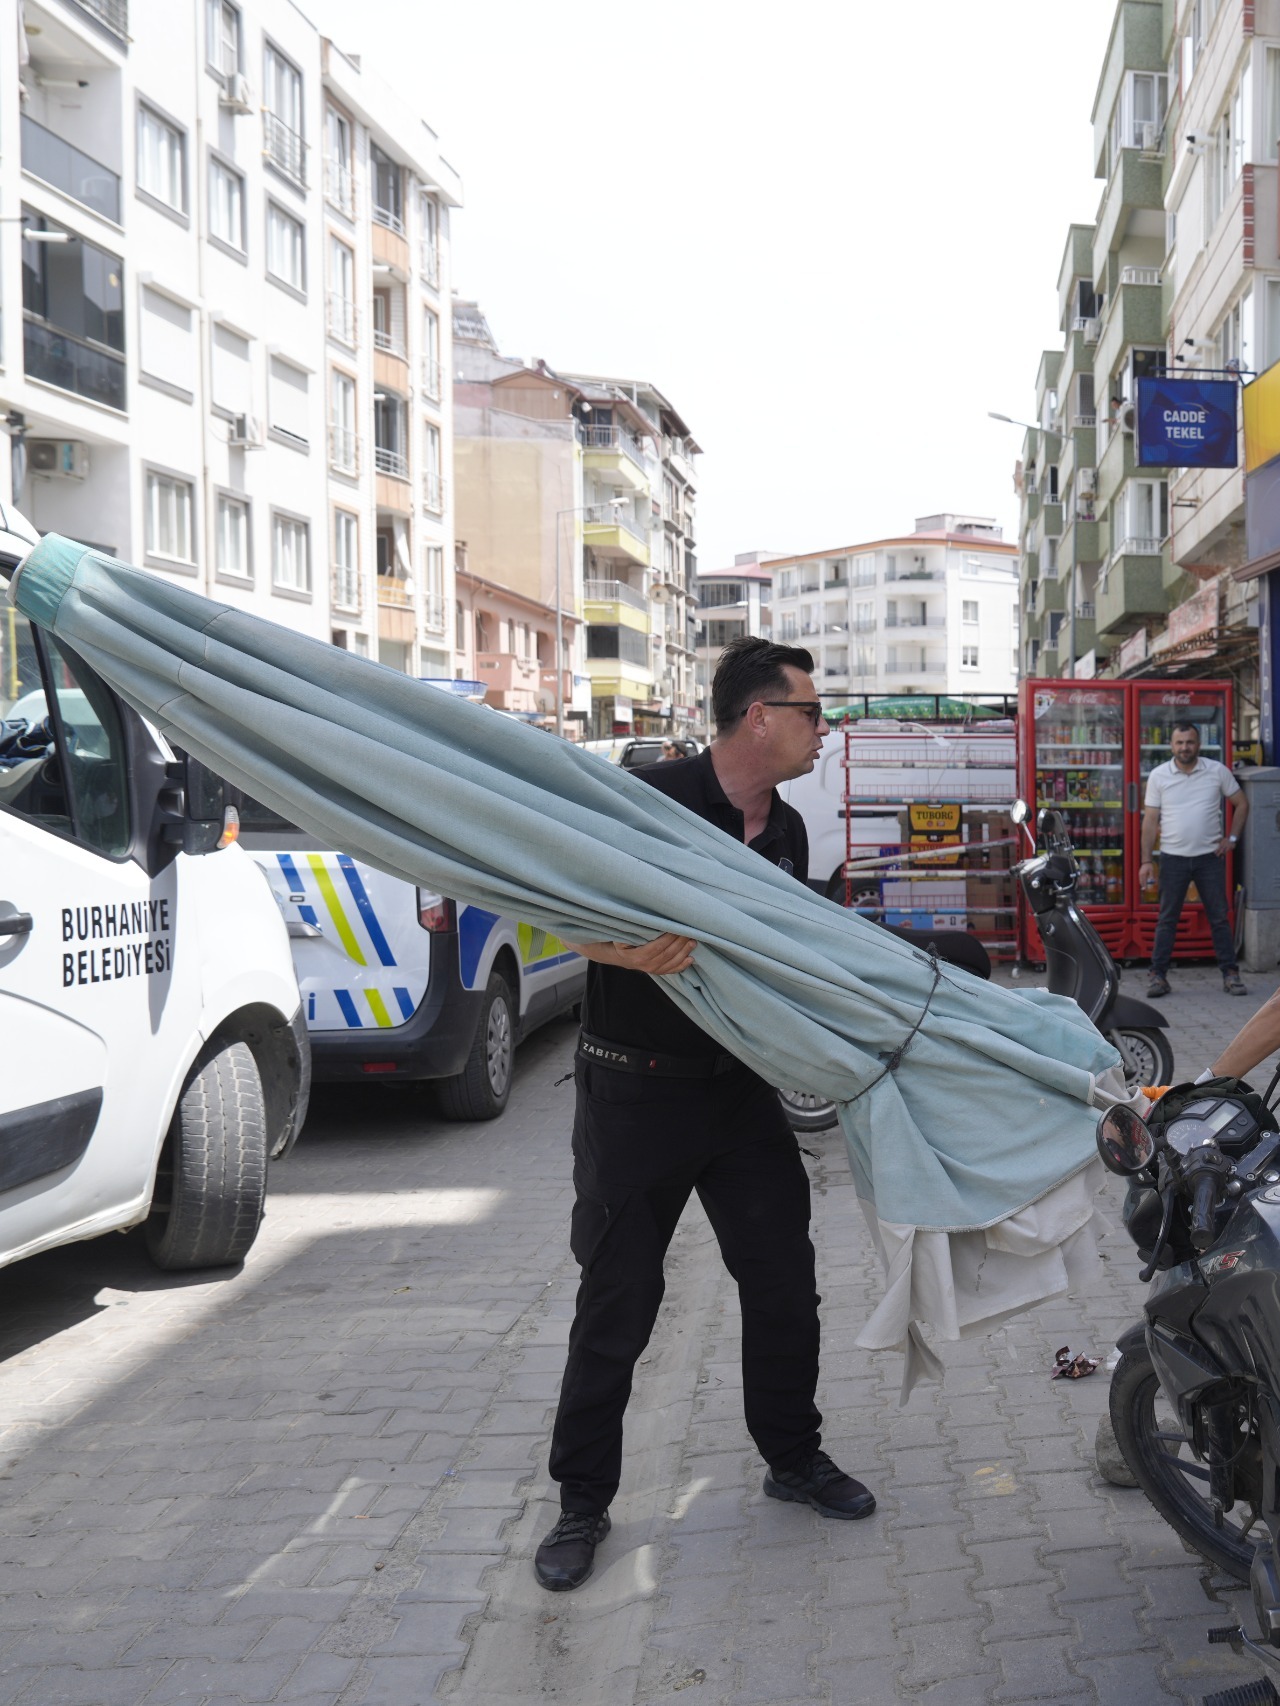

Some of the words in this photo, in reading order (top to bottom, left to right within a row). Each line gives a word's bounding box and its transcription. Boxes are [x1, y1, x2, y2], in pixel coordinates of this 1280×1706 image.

[1163, 410, 1206, 424] CADDE
[1165, 426, 1205, 440] TEKEL
[916, 811, 953, 820] TUBORG
[583, 1042, 628, 1063] ZABITA
